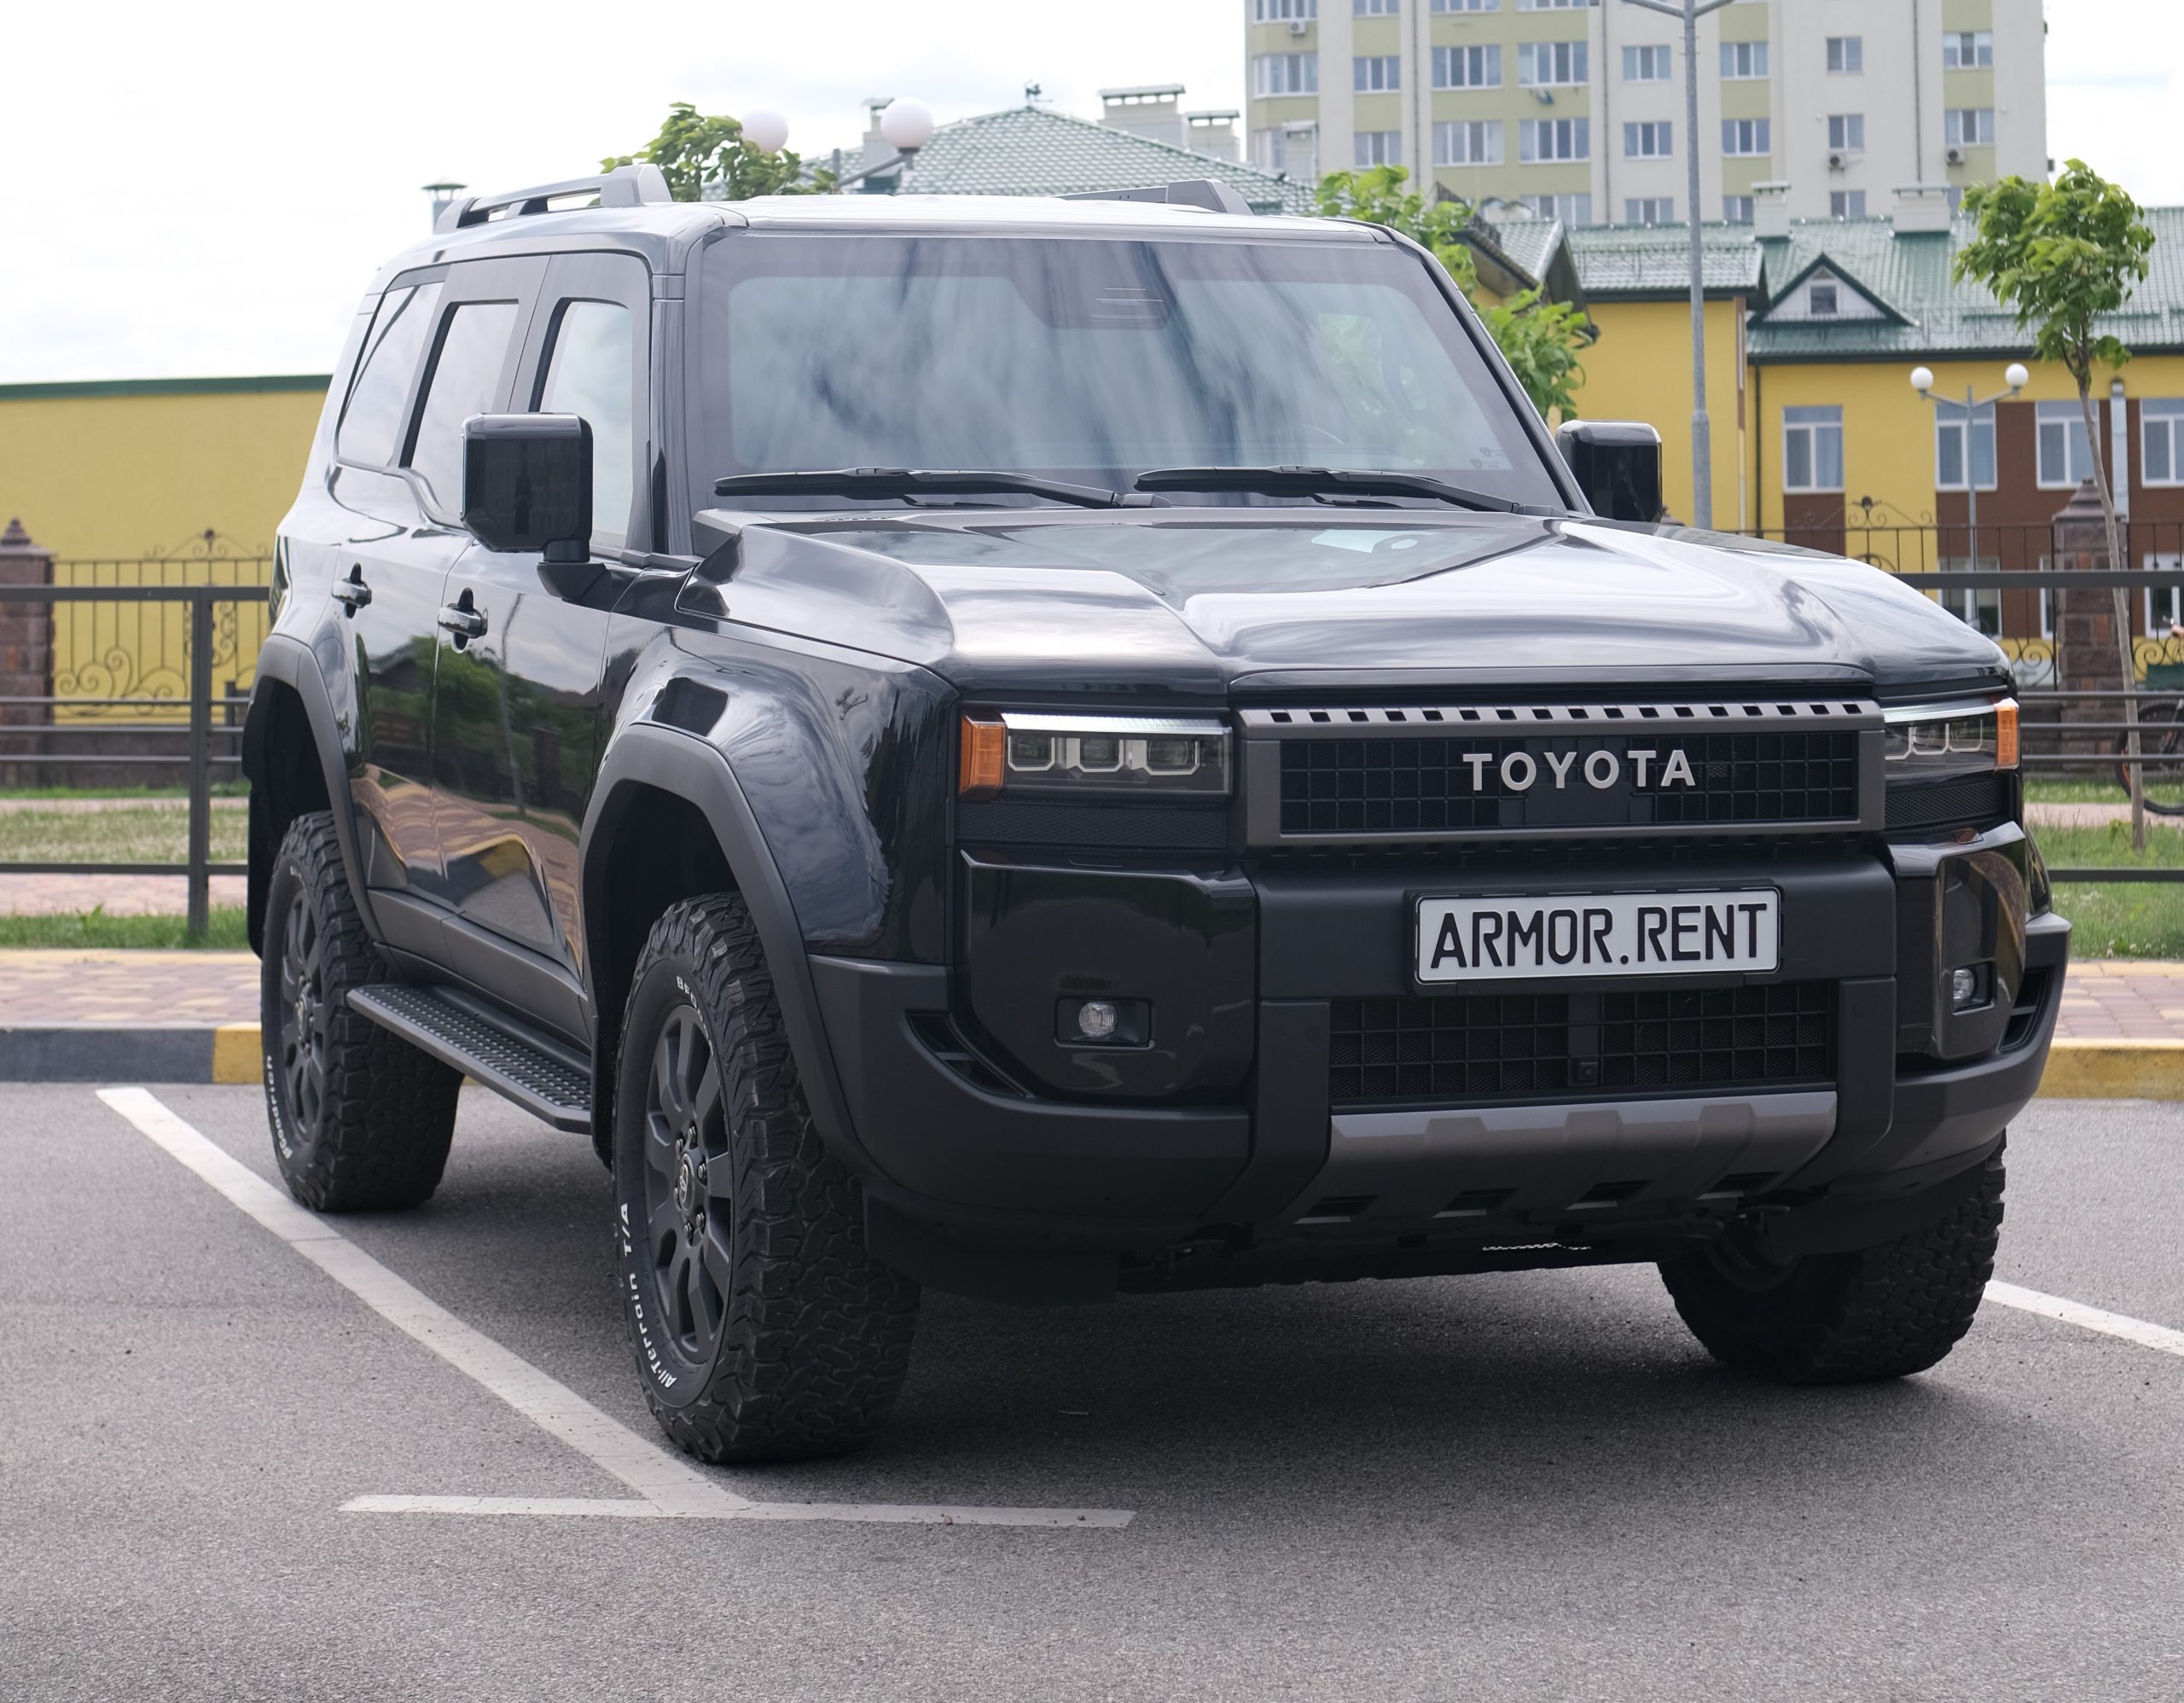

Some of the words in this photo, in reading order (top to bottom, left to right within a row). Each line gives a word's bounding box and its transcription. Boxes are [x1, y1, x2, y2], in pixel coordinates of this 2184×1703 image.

[1462, 749, 1696, 792] TOYOTA
[1430, 902, 1768, 969] ARMOR.RENT
[620, 1203, 632, 1258] T/A
[629, 1273, 677, 1389] All-Terrain
